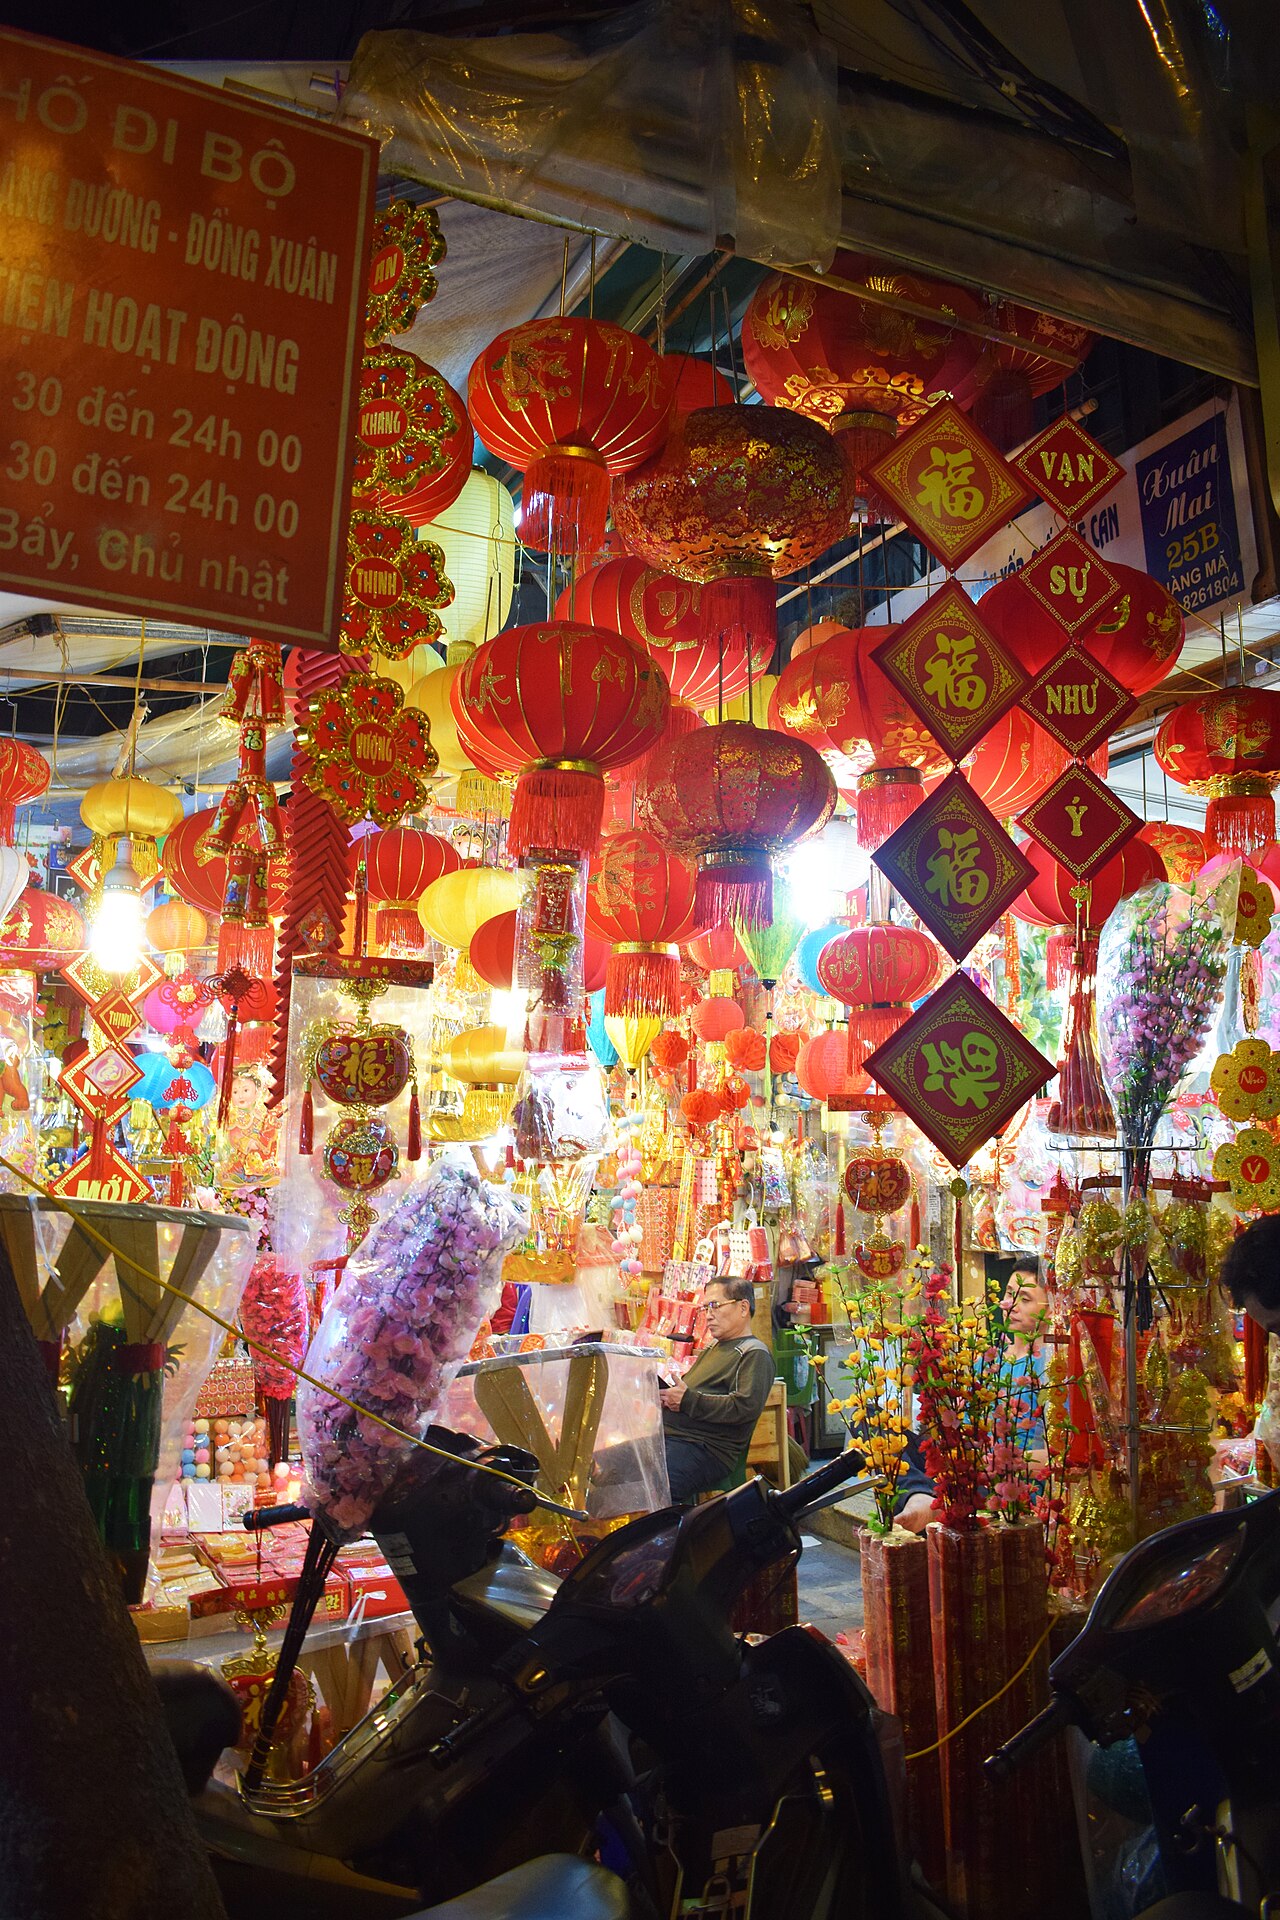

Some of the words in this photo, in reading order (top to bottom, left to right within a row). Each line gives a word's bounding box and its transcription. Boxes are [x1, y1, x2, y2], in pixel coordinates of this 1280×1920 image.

[112, 104, 178, 165] ĐI
[201, 130, 296, 211] BỘ
[184, 207, 261, 282] ĐỒNG
[264, 235, 338, 305] XUÂN
[373, 253, 397, 286] AN
[83, 287, 188, 375] HOẠT
[194, 312, 300, 396] ĐỘNG
[11, 371, 63, 417] 30
[77, 385, 155, 439] đến
[168, 408, 243, 460] 24h
[256, 429, 302, 474] 00
[361, 411, 401, 436] KHANG
[5, 440, 58, 486] 30
[71, 452, 150, 506] đến
[163, 473, 239, 525] 24h
[253, 494, 300, 539] 00
[915, 446, 985, 520] 福
[1039, 450, 1095, 488] VẠN
[1143, 444, 1221, 506] Xuân
[1159, 481, 1216, 538] Mai
[98, 528, 185, 584] Chủ
[200, 555, 289, 613] nhật
[1165, 521, 1220, 572] 25B
[355, 567, 398, 599] THỊNH
[1049, 560, 1091, 604] SỰ
[1183, 571, 1239, 611] 8261804
[923, 632, 987, 711] 福
[1045, 678, 1100, 716] NHƯ
[1064, 796, 1089, 837] Ý
[925, 828, 989, 907] 福
[109, 1010, 132, 1029] THỊNH
[920, 1031, 1001, 1109] 福
[1246, 1158, 1262, 1181] Ý
